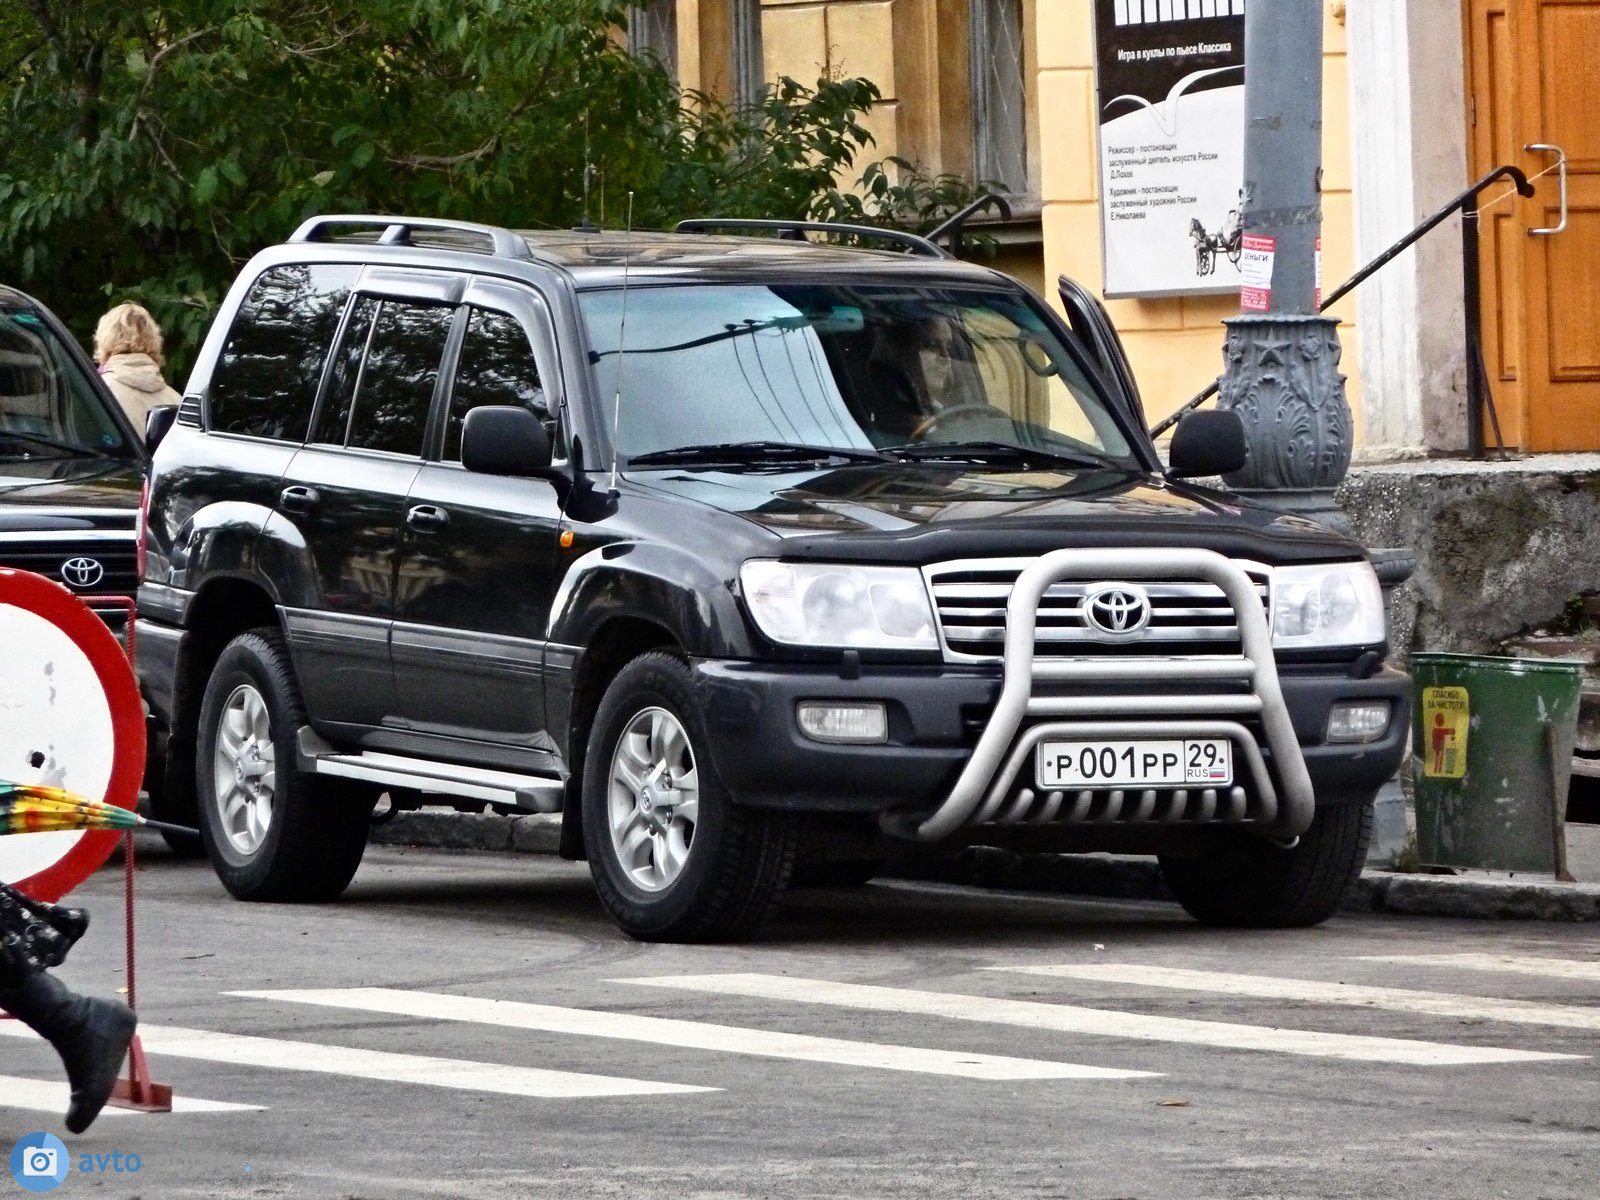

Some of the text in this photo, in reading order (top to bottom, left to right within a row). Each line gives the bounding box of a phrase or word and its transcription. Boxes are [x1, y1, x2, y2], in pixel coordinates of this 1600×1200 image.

[1117, 42, 1232, 62] Игра в куклы по пьесе Классика
[1108, 146, 1135, 155] Режиссер
[1140, 143, 1177, 153] постановщик
[1109, 152, 1218, 168] заслуженный деятель искусств России
[1109, 187, 1137, 198] Художник
[1141, 185, 1178, 194] постановщик
[1110, 194, 1197, 209] заслуженный художник России
[1110, 210, 1146, 220] Е.Николаева
[1188, 743, 1217, 768] 29
[1187, 769, 1209, 778] RUS
